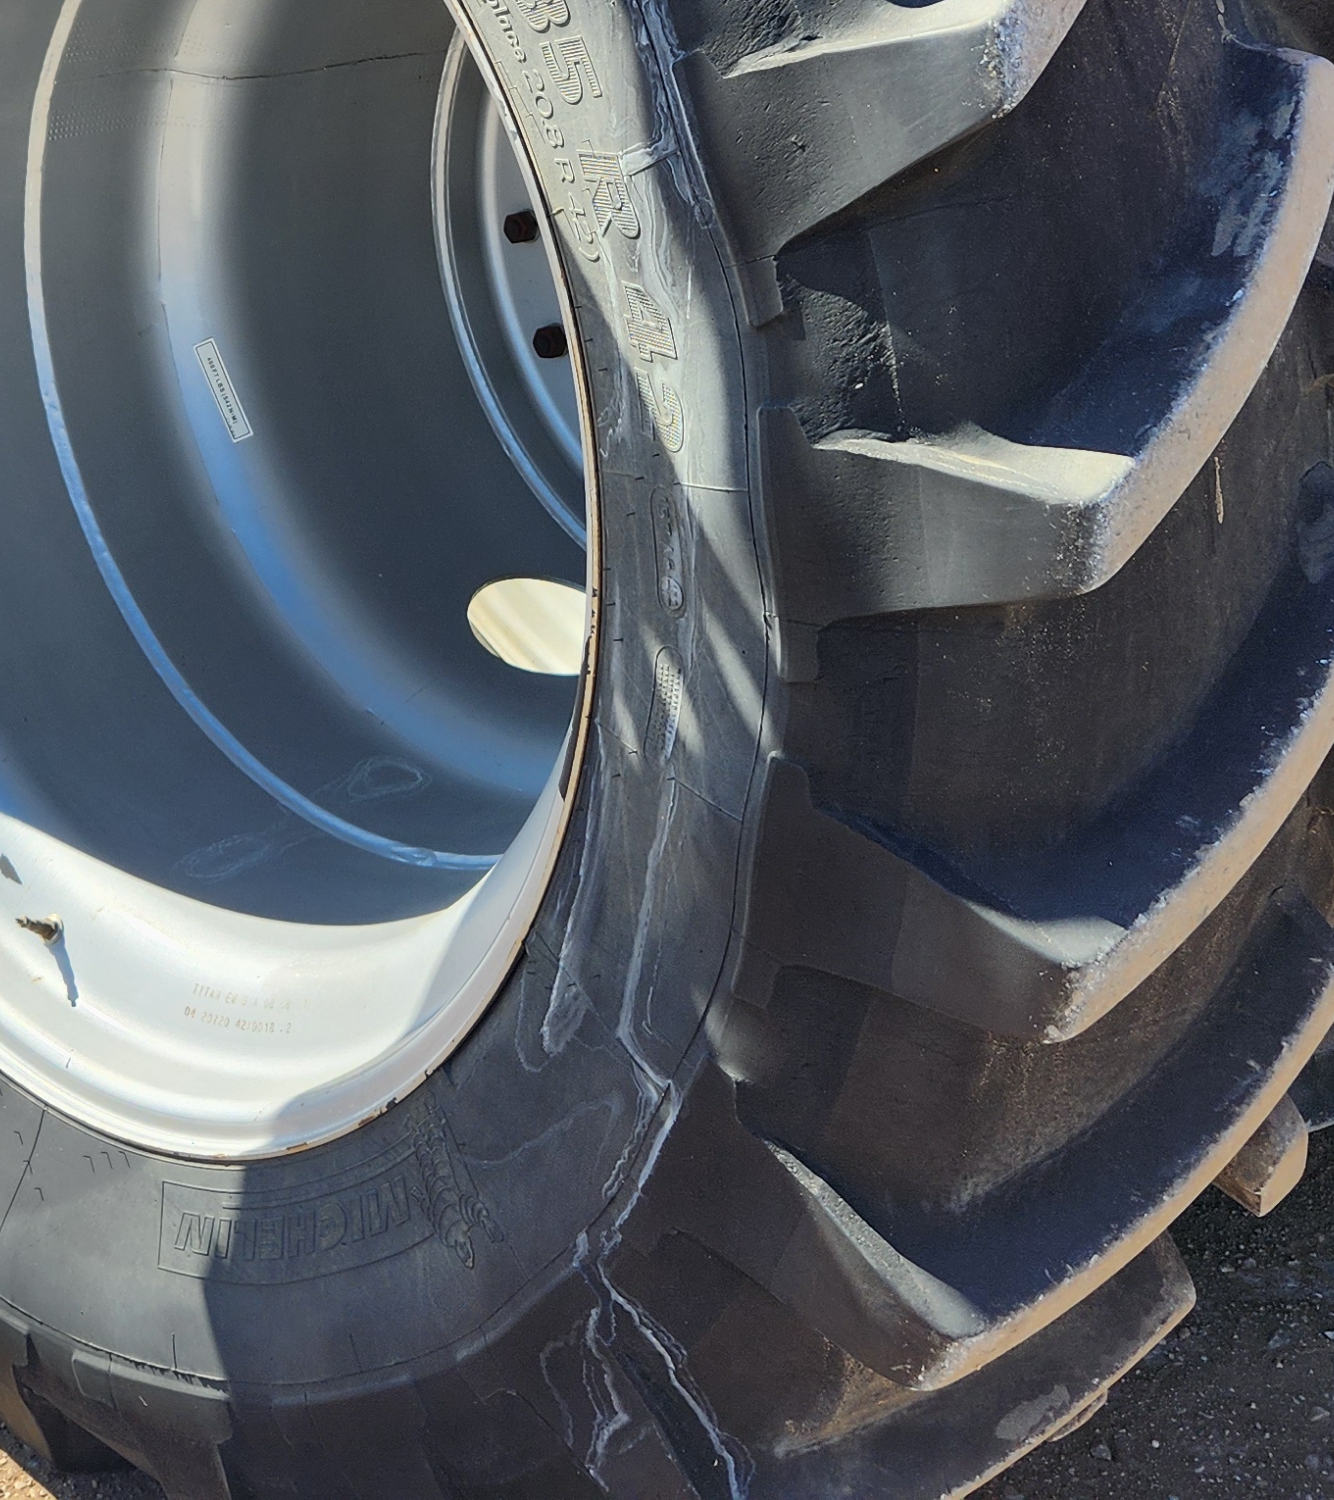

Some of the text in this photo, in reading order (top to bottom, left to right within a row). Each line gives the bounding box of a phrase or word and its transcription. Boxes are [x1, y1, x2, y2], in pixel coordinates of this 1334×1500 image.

[521, 69, 565, 148] 20.8
[554, 157, 575, 183] R
[576, 148, 641, 239] R
[622, 280, 685, 453] 42
[174, 1174, 411, 1262] MICHELIN
